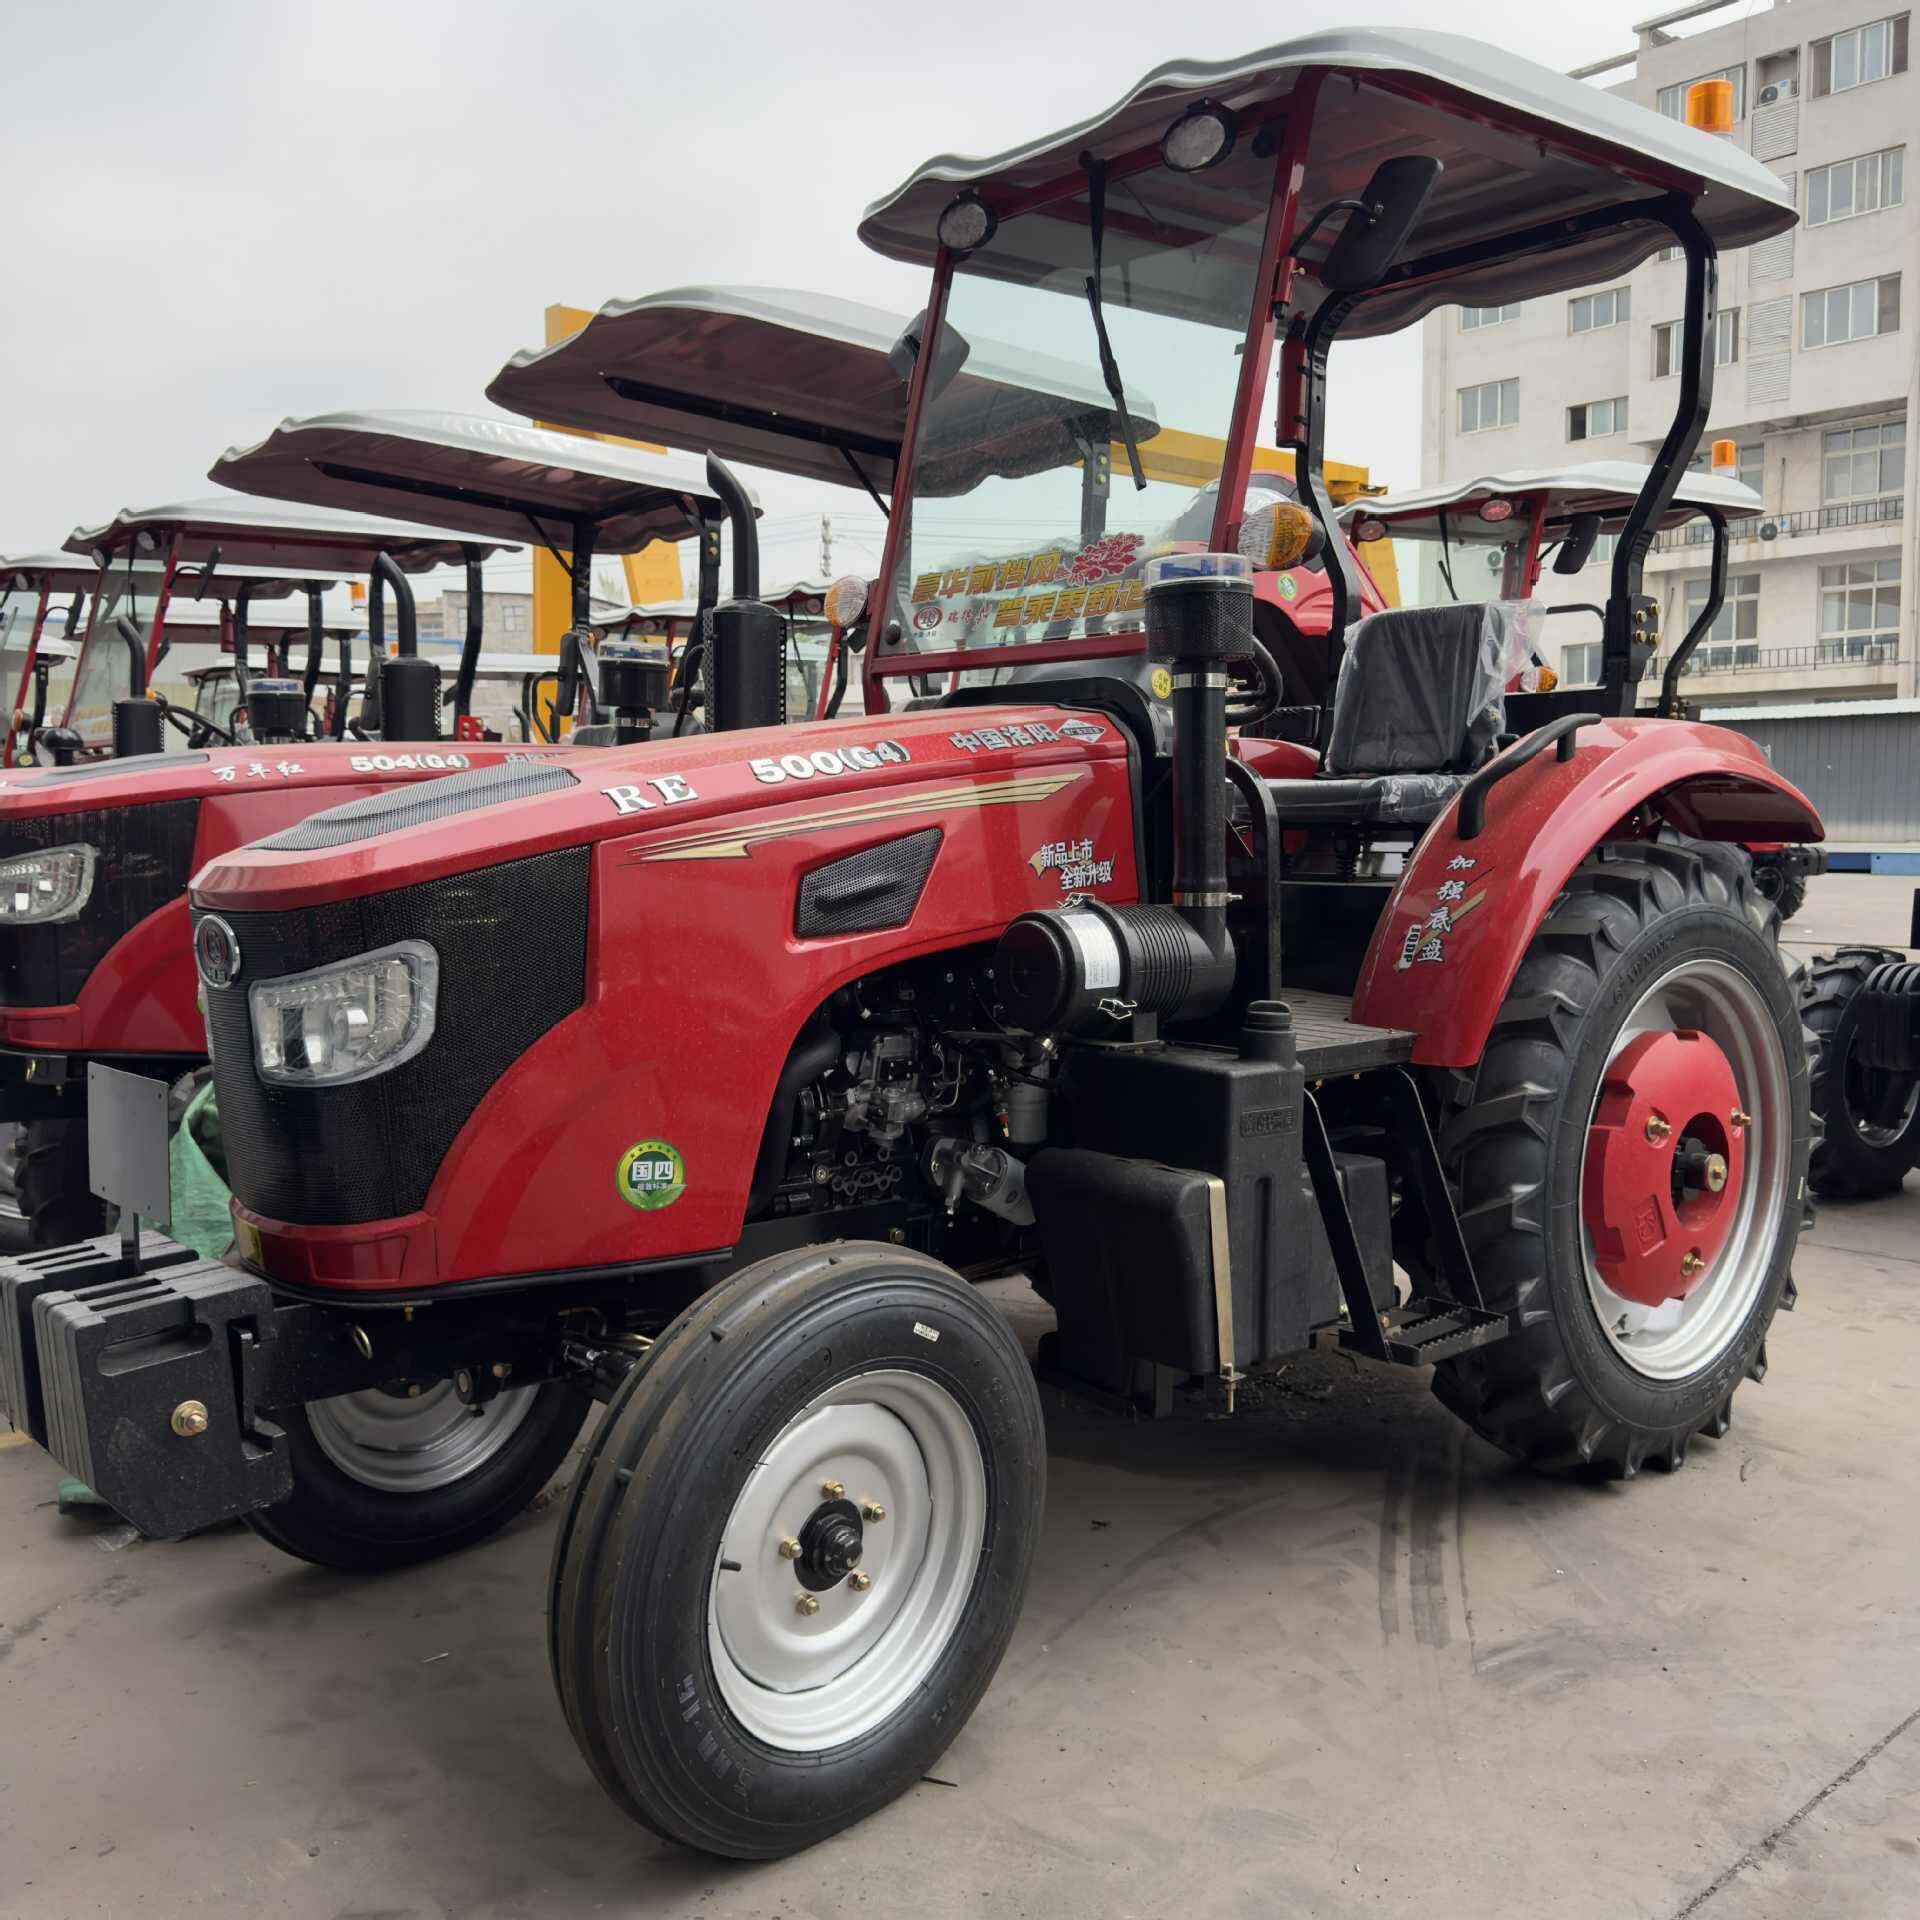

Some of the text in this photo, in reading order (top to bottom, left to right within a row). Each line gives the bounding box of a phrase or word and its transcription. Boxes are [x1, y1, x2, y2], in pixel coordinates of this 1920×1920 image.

[911, 550, 1064, 603] 豪华前挡风
[350, 754, 470, 773] 504(G4)
[749, 740, 911, 784] 500(G4)
[949, 723, 1060, 753] 中国洛阳
[1040, 838, 1093, 867] 新品上市
[1060, 861, 1112, 890] 全新升级
[1417, 854, 1477, 963] 加强底盘
[632, 1161, 674, 1181] 国四
